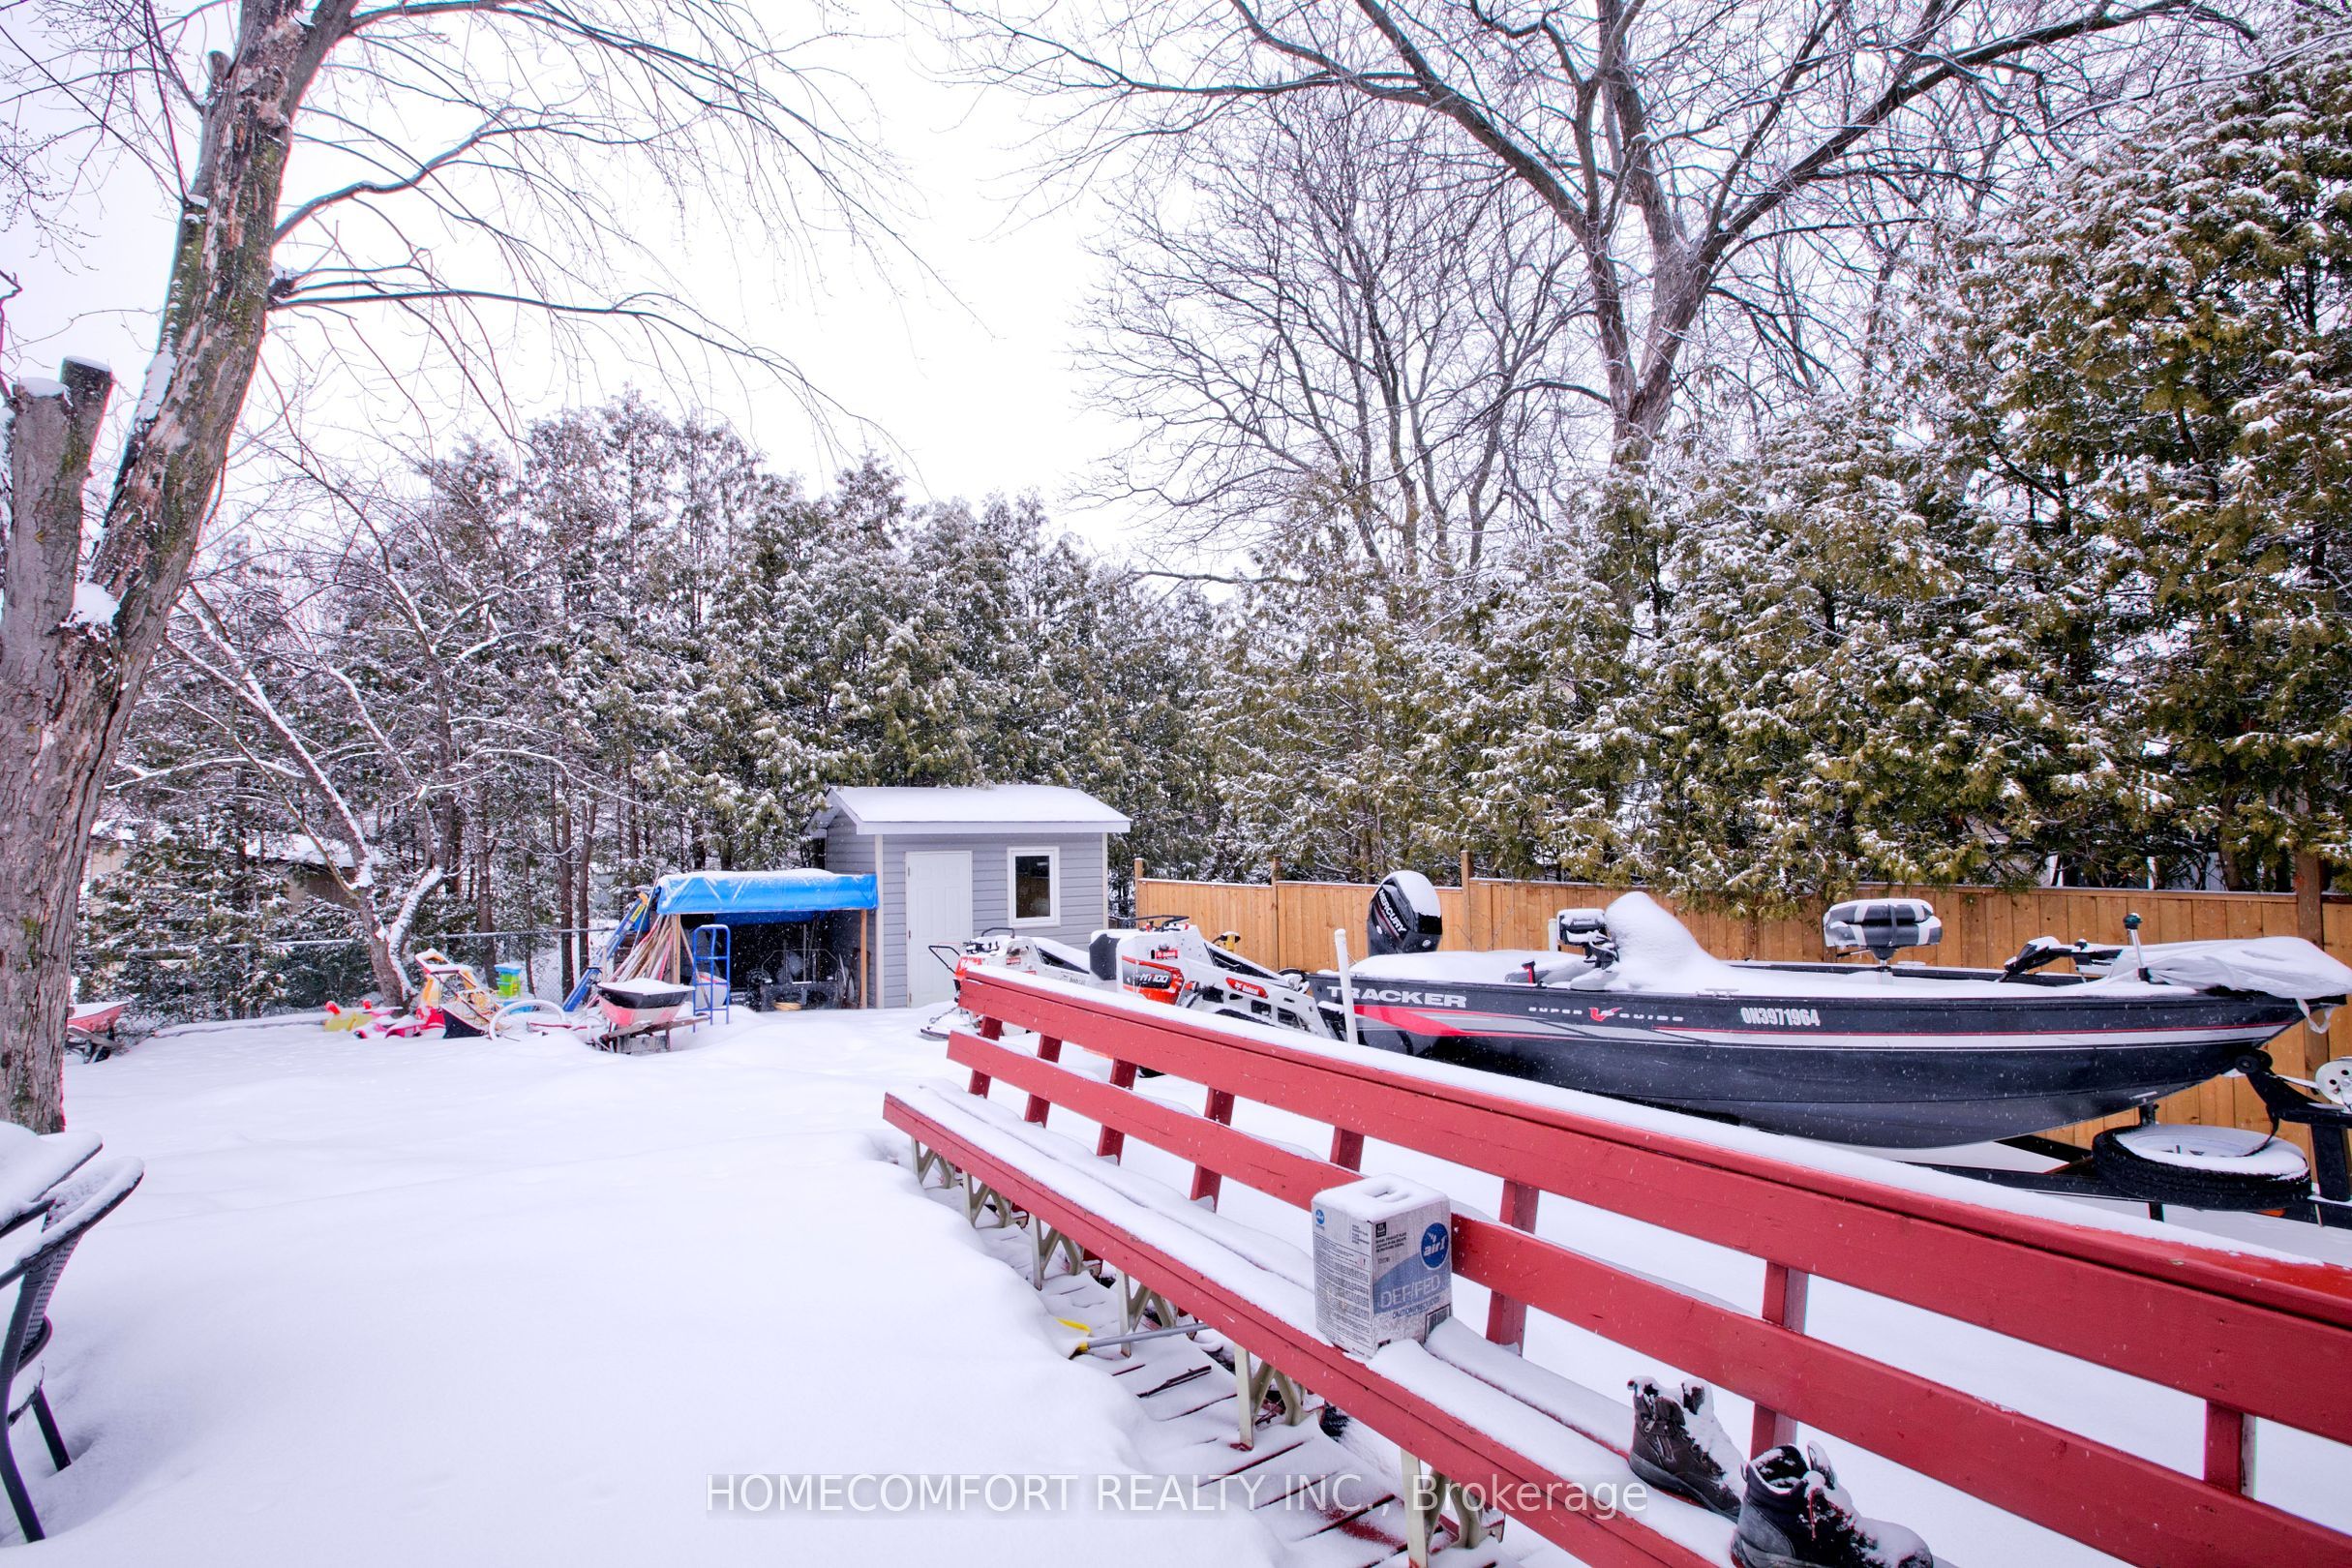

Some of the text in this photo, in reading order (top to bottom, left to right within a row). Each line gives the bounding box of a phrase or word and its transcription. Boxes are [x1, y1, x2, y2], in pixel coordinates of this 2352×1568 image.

[1377, 889, 1407, 932] MERCURY
[1326, 985, 1467, 1009] TRACKER
[1740, 1007, 1821, 1026] ON3971964
[1380, 1275, 1441, 1308] DEF/FED
